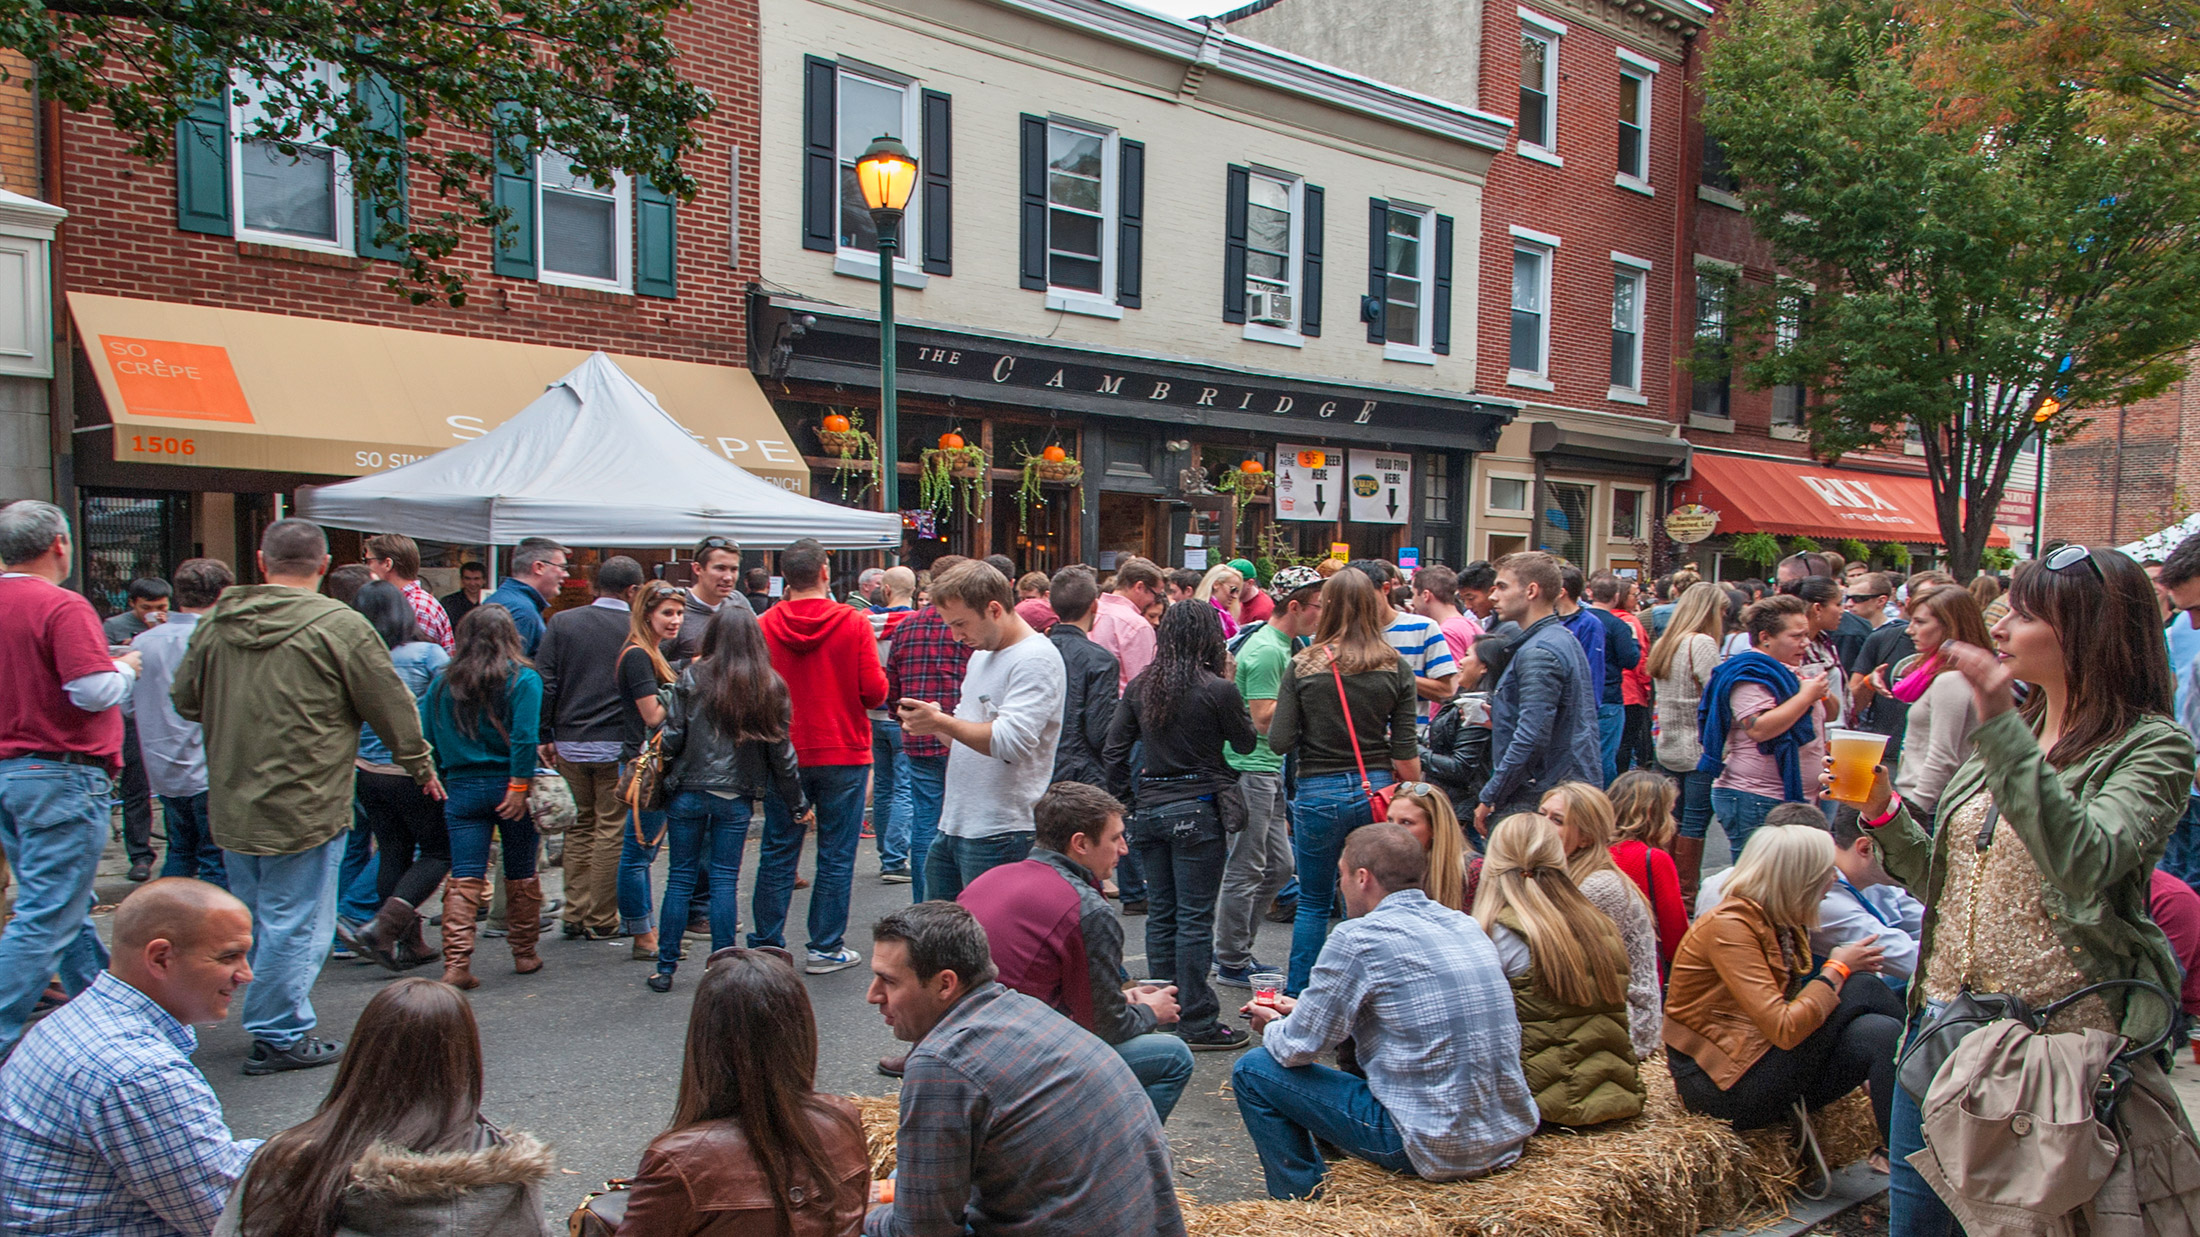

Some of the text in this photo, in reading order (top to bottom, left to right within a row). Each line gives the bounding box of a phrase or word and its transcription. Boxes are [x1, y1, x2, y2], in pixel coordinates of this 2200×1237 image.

[109, 341, 147, 358] SO
[117, 358, 202, 380] CRÊPE
[918, 347, 1377, 425] THE CAMBRIDGE
[131, 435, 197, 456] 1506
[355, 451, 383, 468] SO
[1325, 455, 1341, 466] BEER
[1375, 457, 1409, 471] GOOD FOOD
[1312, 468, 1328, 480] HERE
[1384, 472, 1400, 484] HERE
[1798, 475, 1899, 511] REX
